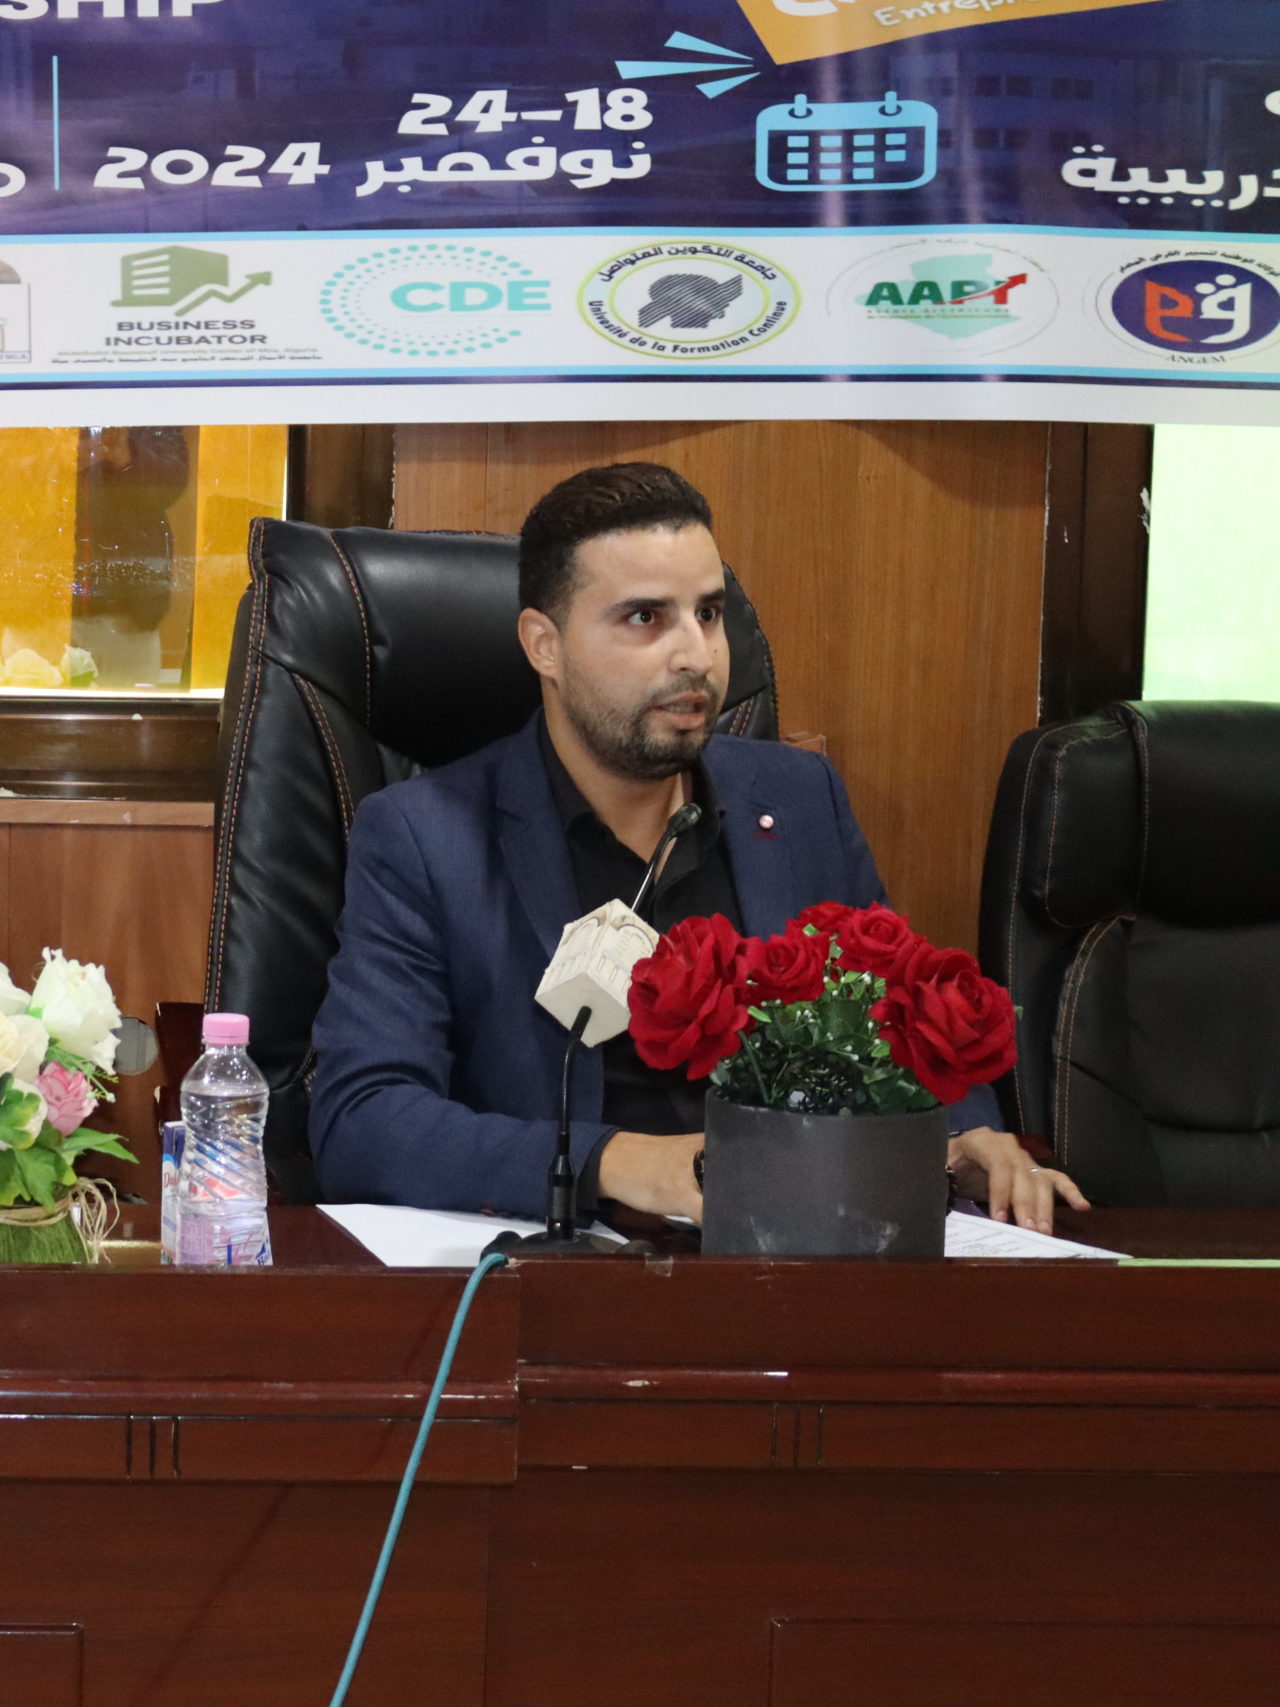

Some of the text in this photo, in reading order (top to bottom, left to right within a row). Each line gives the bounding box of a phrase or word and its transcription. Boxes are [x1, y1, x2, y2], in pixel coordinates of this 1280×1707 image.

[93, 135, 653, 198] نوفمبر 2024
[597, 245, 777, 283] جامعة التكوين المتواصل
[389, 280, 552, 313] CDE
[104, 334, 268, 346] INCUBATOR
[116, 319, 256, 332] BUSINESS
[629, 336, 647, 347] de
[651, 341, 666, 351] la
[672, 336, 750, 353] Formation
[748, 300, 788, 337] Continue
